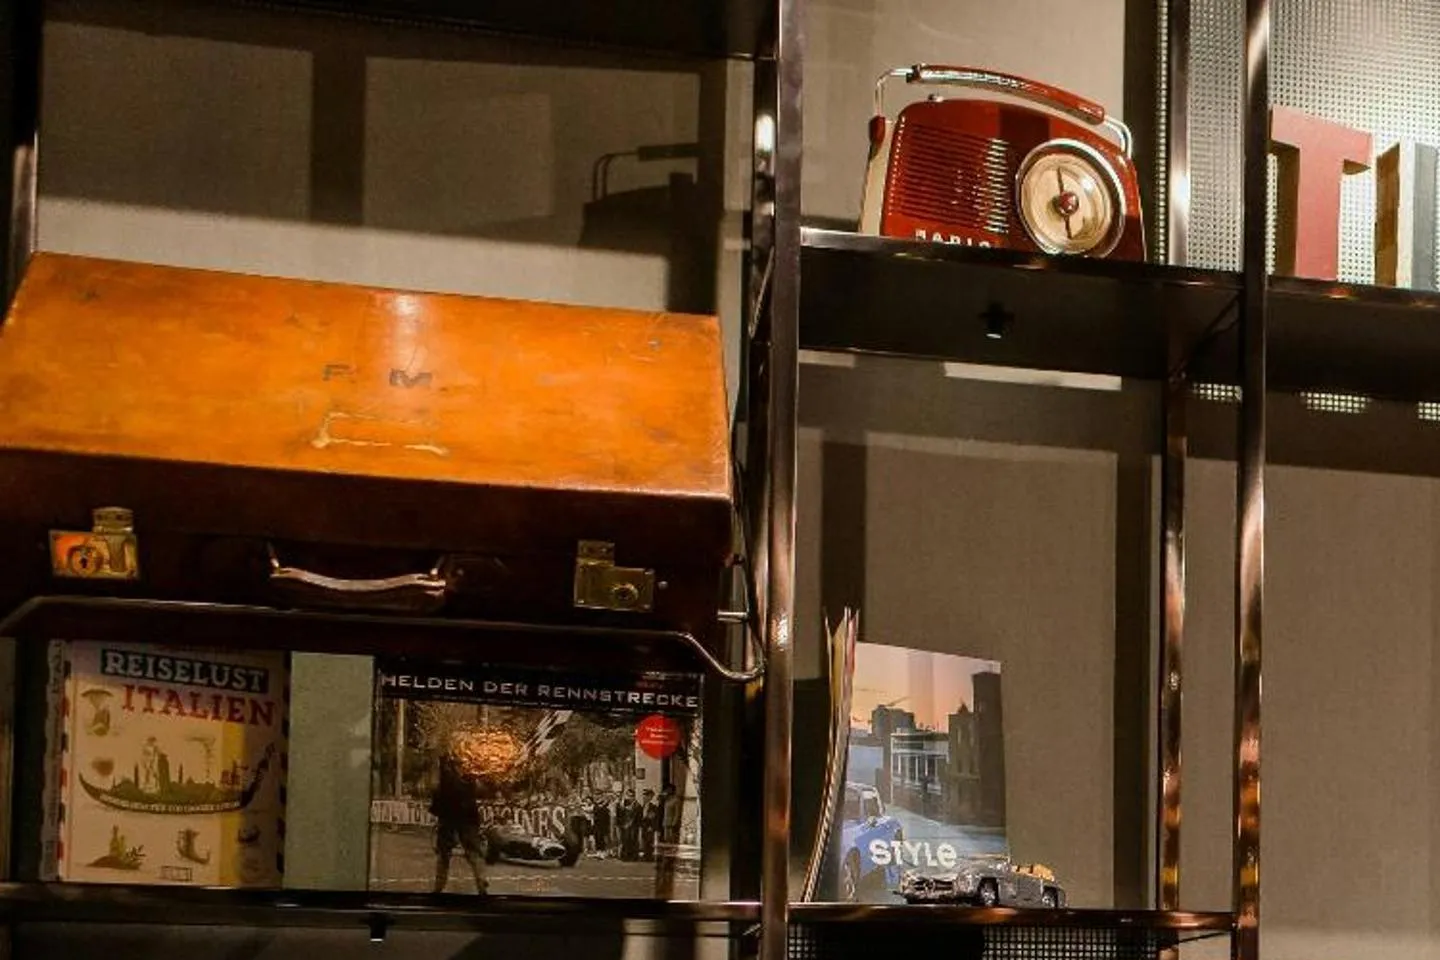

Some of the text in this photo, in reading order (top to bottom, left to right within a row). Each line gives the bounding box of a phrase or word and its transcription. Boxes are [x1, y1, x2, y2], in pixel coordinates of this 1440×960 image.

[104, 651, 266, 692] REISELUST
[381, 674, 698, 708] HELDEN DER RENNSTRECKE
[121, 684, 276, 726] ITALIEN
